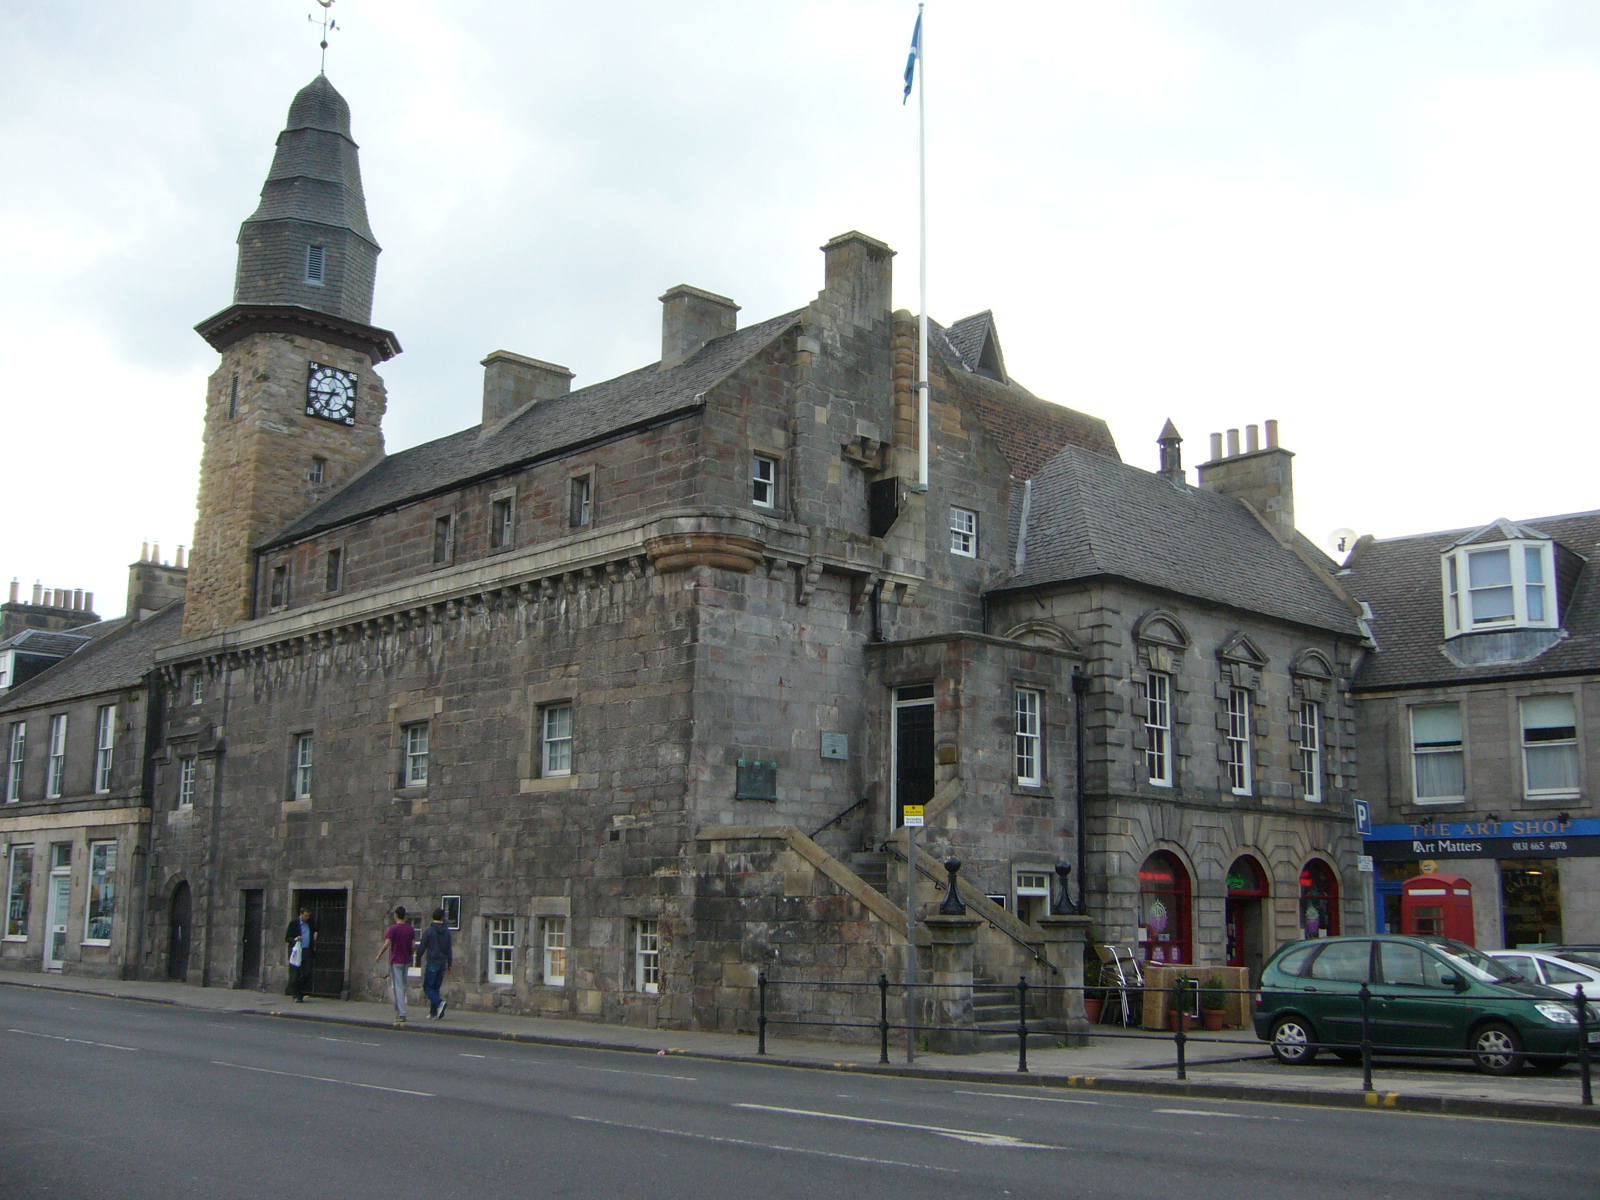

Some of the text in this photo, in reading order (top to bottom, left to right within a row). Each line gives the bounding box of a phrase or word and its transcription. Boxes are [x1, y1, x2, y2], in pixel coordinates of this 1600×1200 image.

[1358, 804, 1366, 828] P
[1410, 820, 1572, 836] THE ART SHOP
[1413, 840, 1482, 852] Art Matters
[1530, 841, 1545, 850] 665
